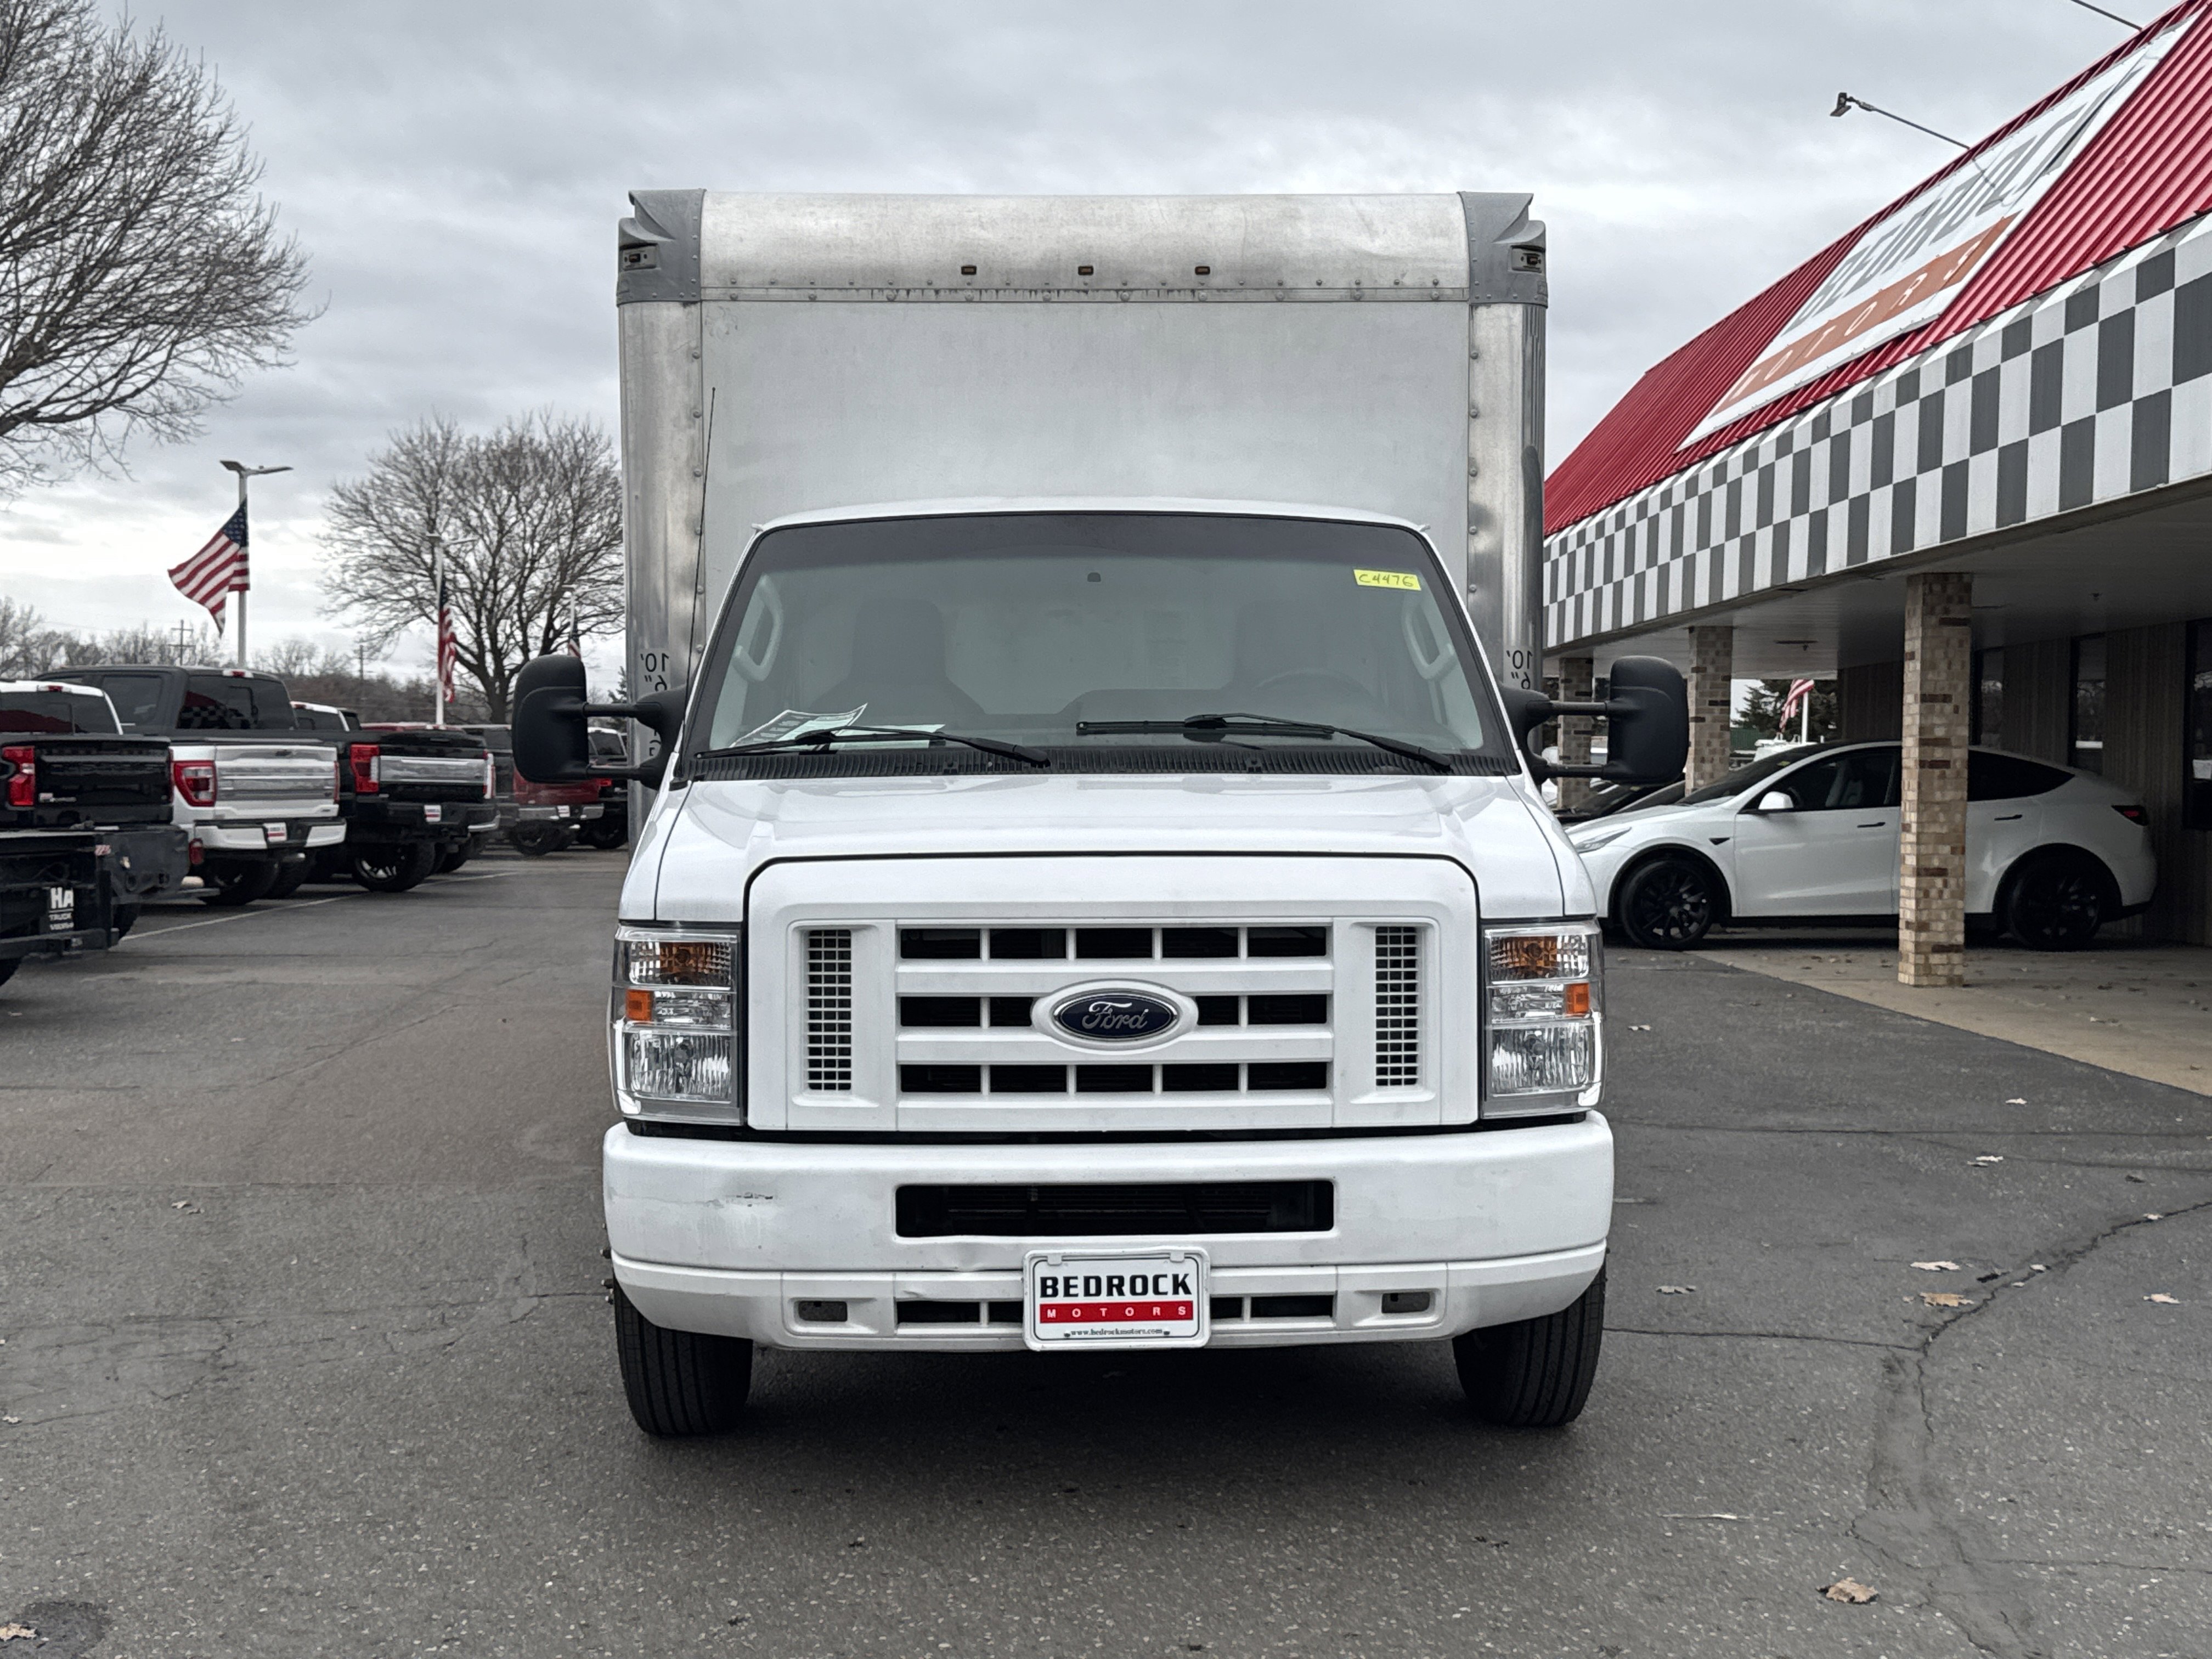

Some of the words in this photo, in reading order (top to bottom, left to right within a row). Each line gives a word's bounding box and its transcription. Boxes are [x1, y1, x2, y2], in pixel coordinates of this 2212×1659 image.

[1729, 240, 1982, 402] MOTORS
[1359, 574, 1414, 586] C4476
[1081, 1001, 1150, 1030] Ford
[1040, 1273, 1192, 1297] BEDROCK
[1047, 1306, 1186, 1318] MOTORS
